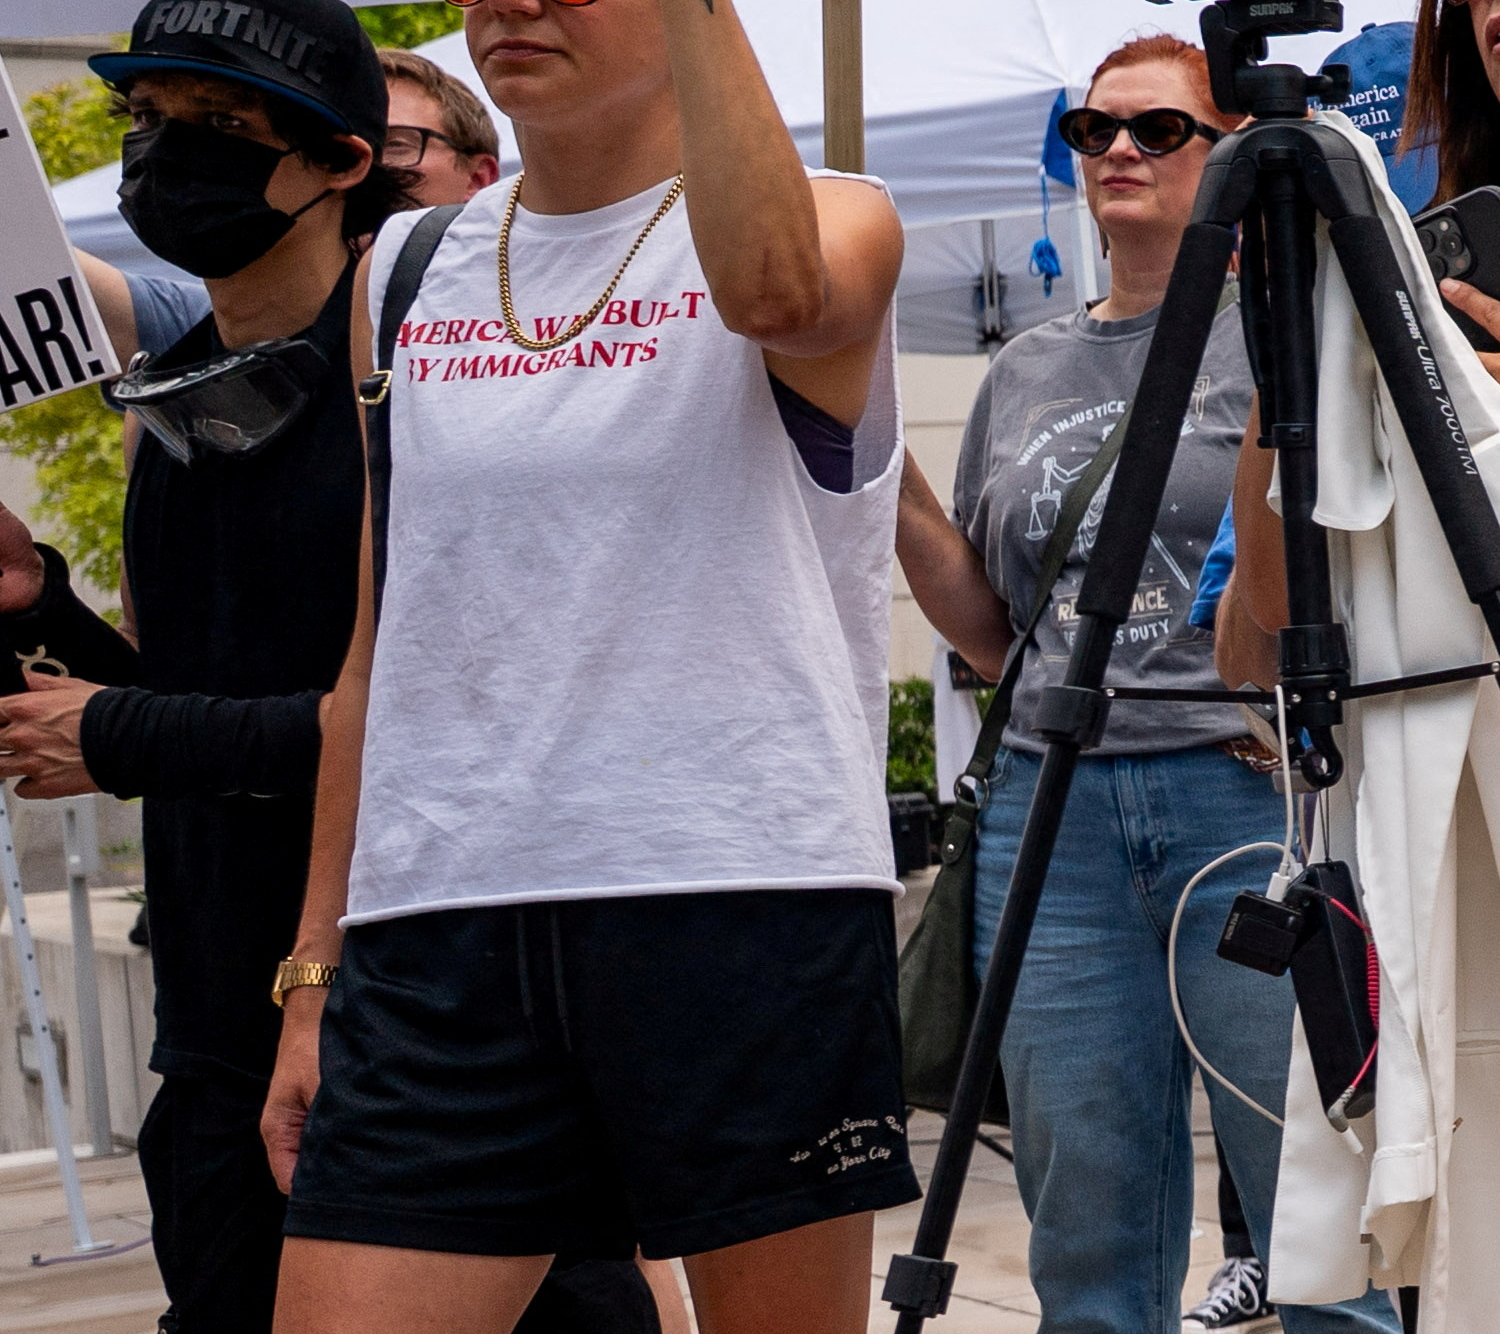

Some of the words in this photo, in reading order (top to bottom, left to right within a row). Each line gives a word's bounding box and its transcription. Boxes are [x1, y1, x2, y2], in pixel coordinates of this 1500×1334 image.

[441, 337, 659, 382] IMMIGRANTS
[1417, 343, 1442, 390] Ultra
[1016, 430, 1053, 466] WHEN
[1053, 400, 1127, 434] INJUSTICE
[1130, 618, 1170, 643] DUTY
